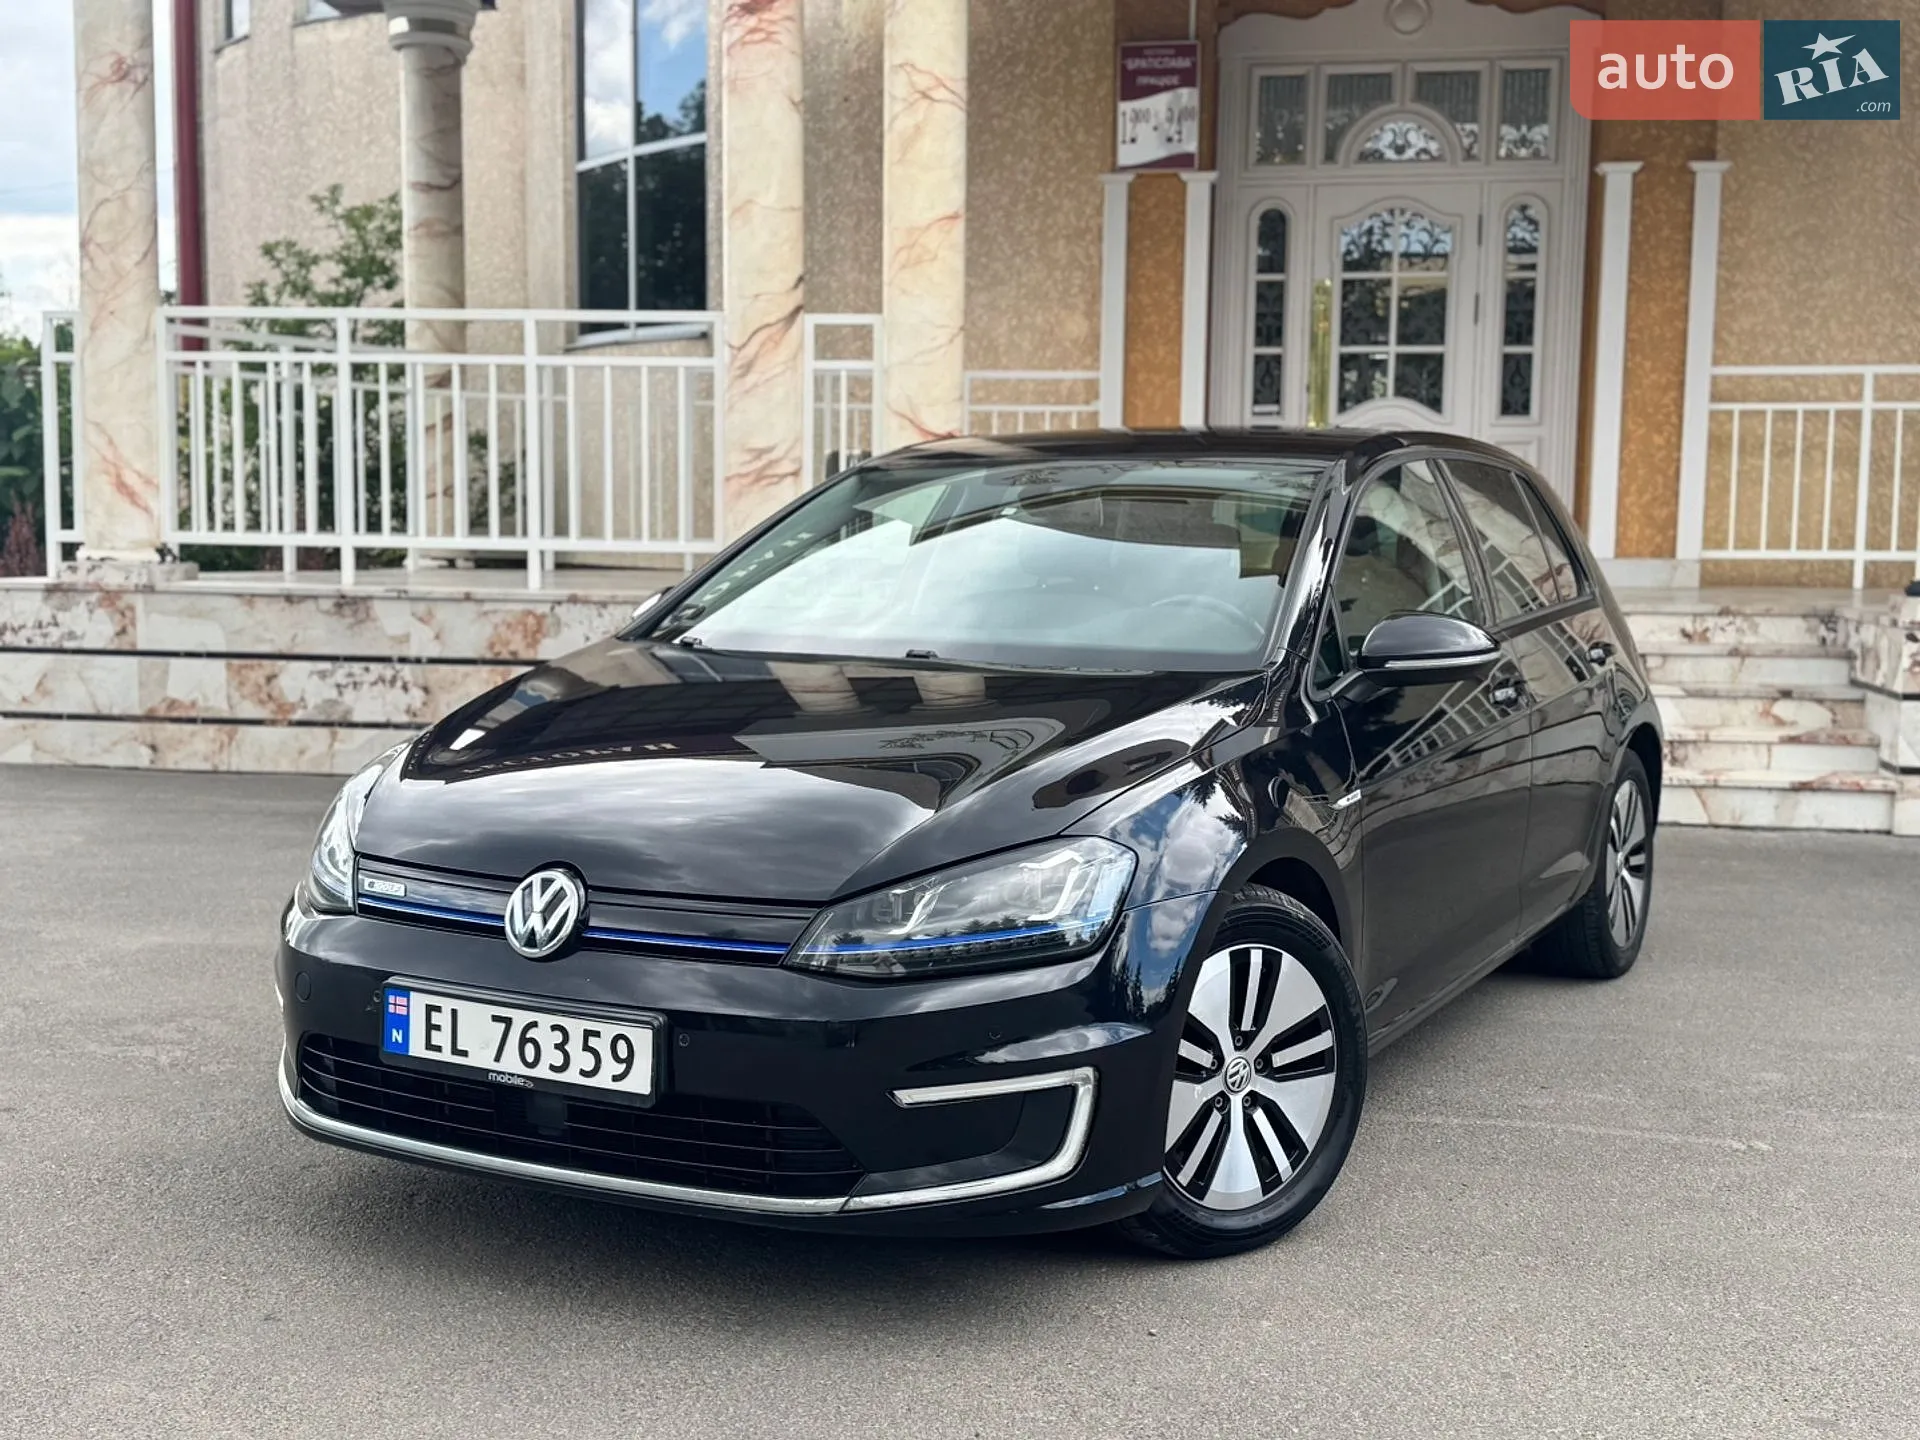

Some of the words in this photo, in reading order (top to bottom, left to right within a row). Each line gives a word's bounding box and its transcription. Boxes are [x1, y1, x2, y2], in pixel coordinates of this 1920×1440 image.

[391, 1029, 403, 1044] N
[424, 1003, 469, 1058] EL
[490, 1014, 635, 1083] 76359
